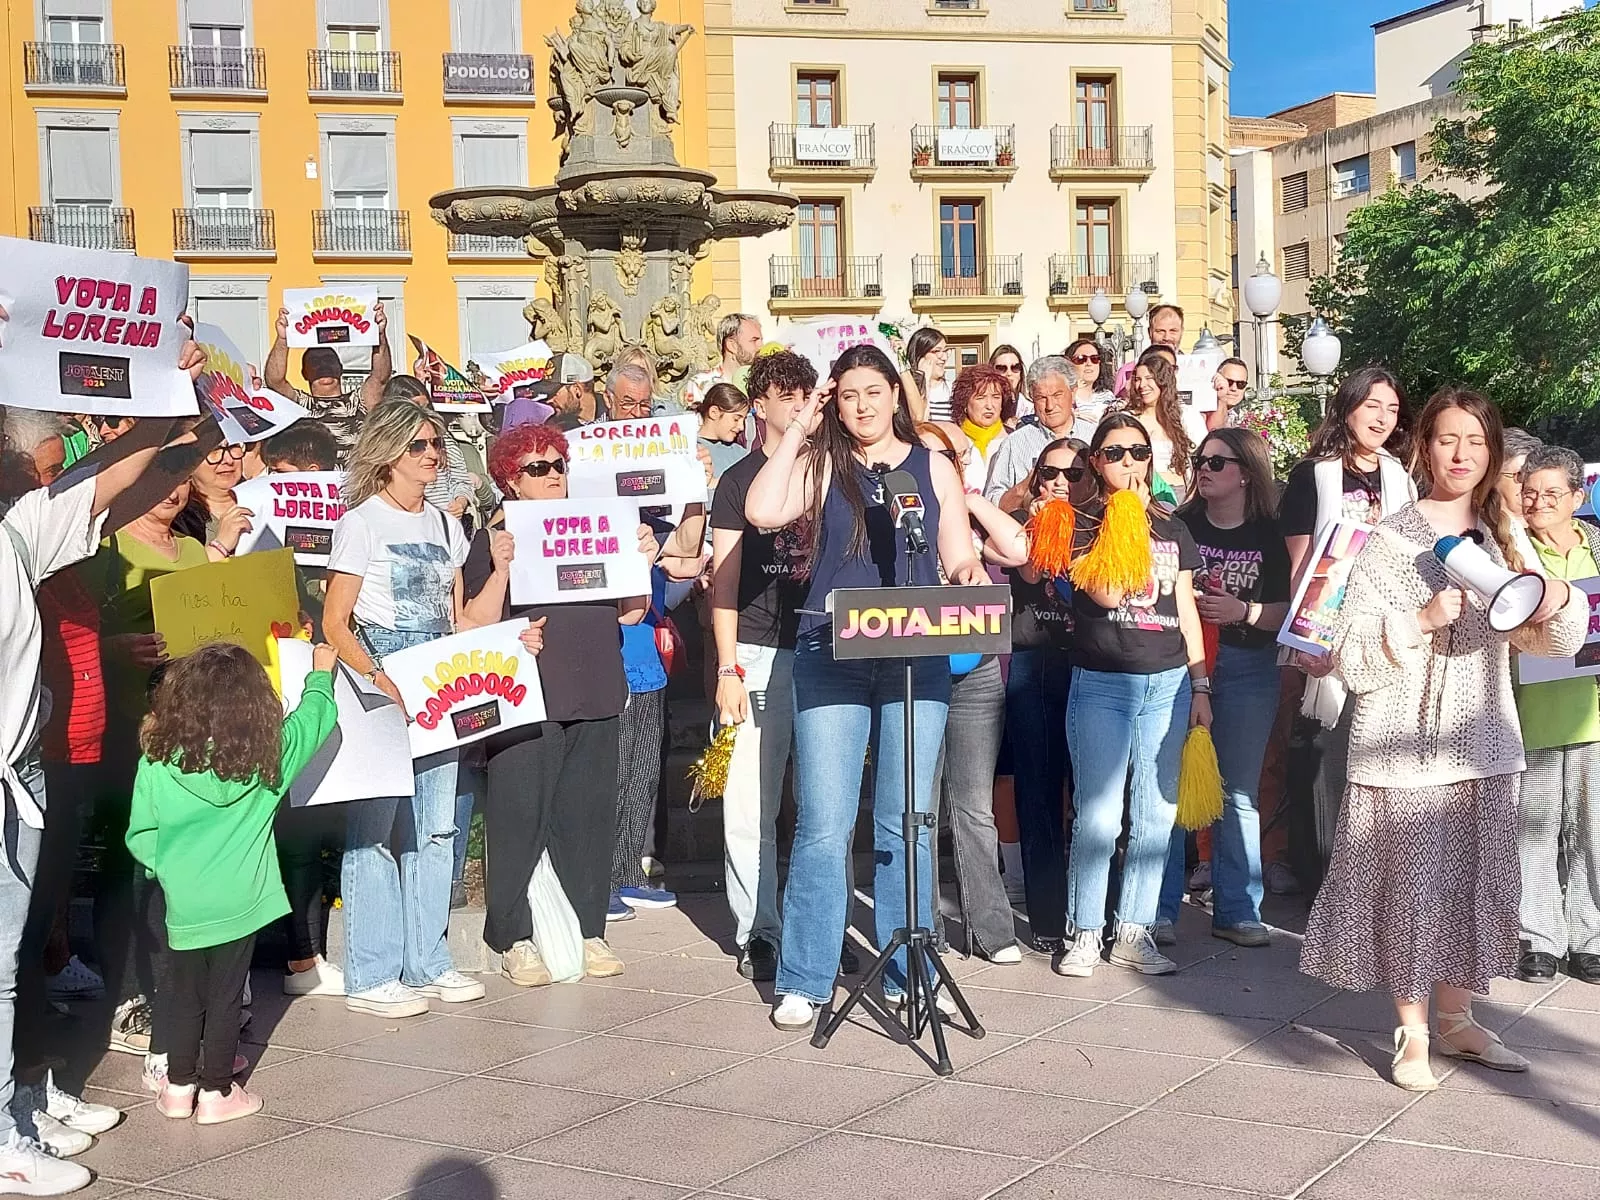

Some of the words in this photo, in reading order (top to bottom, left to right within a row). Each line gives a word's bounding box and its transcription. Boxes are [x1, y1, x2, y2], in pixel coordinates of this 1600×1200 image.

[448, 63, 530, 80] PODÓLOGO
[55, 275, 132, 313] VOTA
[137, 287, 158, 316] A
[42, 309, 162, 348] LORENA
[294, 306, 371, 335] GANADORA
[64, 364, 125, 382] JOTALENT
[82, 379, 105, 388] 2024
[580, 423, 661, 440] LORENA
[669, 422, 682, 436] A
[578, 444, 604, 462] LA
[611, 434, 689, 460] FINAL!!!
[270, 482, 323, 498] VOTA
[543, 515, 592, 536] VOTA
[598, 515, 611, 533] A
[542, 536, 619, 557] LORENA
[1226, 550, 1263, 563] MATA
[761, 564, 789, 574] VOTA
[790, 564, 799, 574] A
[221, 582, 249, 608] ha
[838, 604, 1007, 640] JOTALENT
[1034, 611, 1062, 621] VOTA
[422, 650, 519, 693] LORENA
[415, 672, 527, 731] GANADORA
